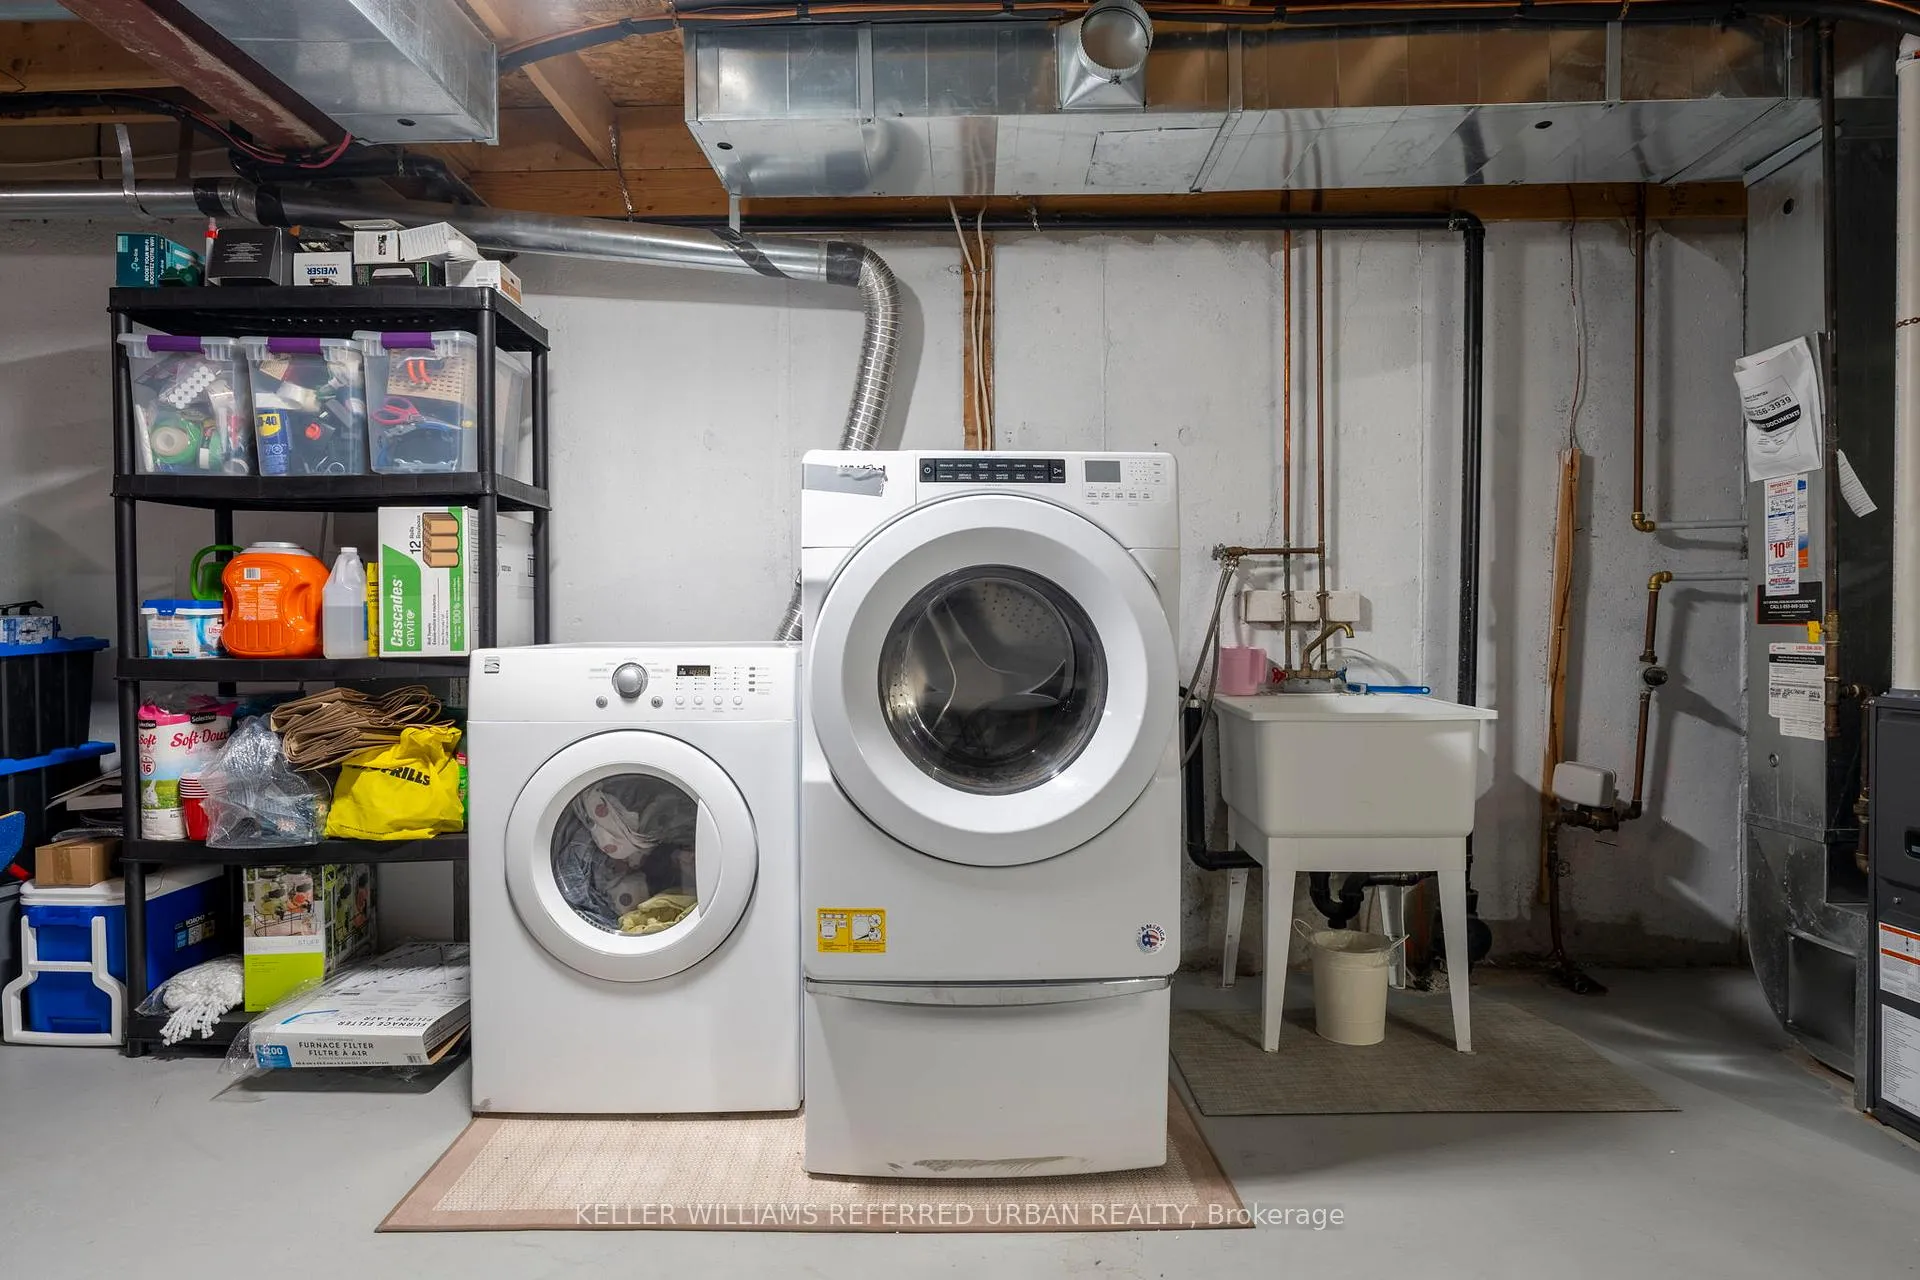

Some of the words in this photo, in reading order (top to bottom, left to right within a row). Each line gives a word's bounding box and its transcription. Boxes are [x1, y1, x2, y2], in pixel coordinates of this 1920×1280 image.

[306, 267, 338, 275] WEISER
[408, 540, 421, 555] 12
[1785, 540, 1794, 549] OFF
[390, 579, 403, 647] Cascades
[143, 763, 151, 773] 16
[299, 1041, 339, 1049] FURNACE
[308, 1049, 339, 1057] FILTRE
